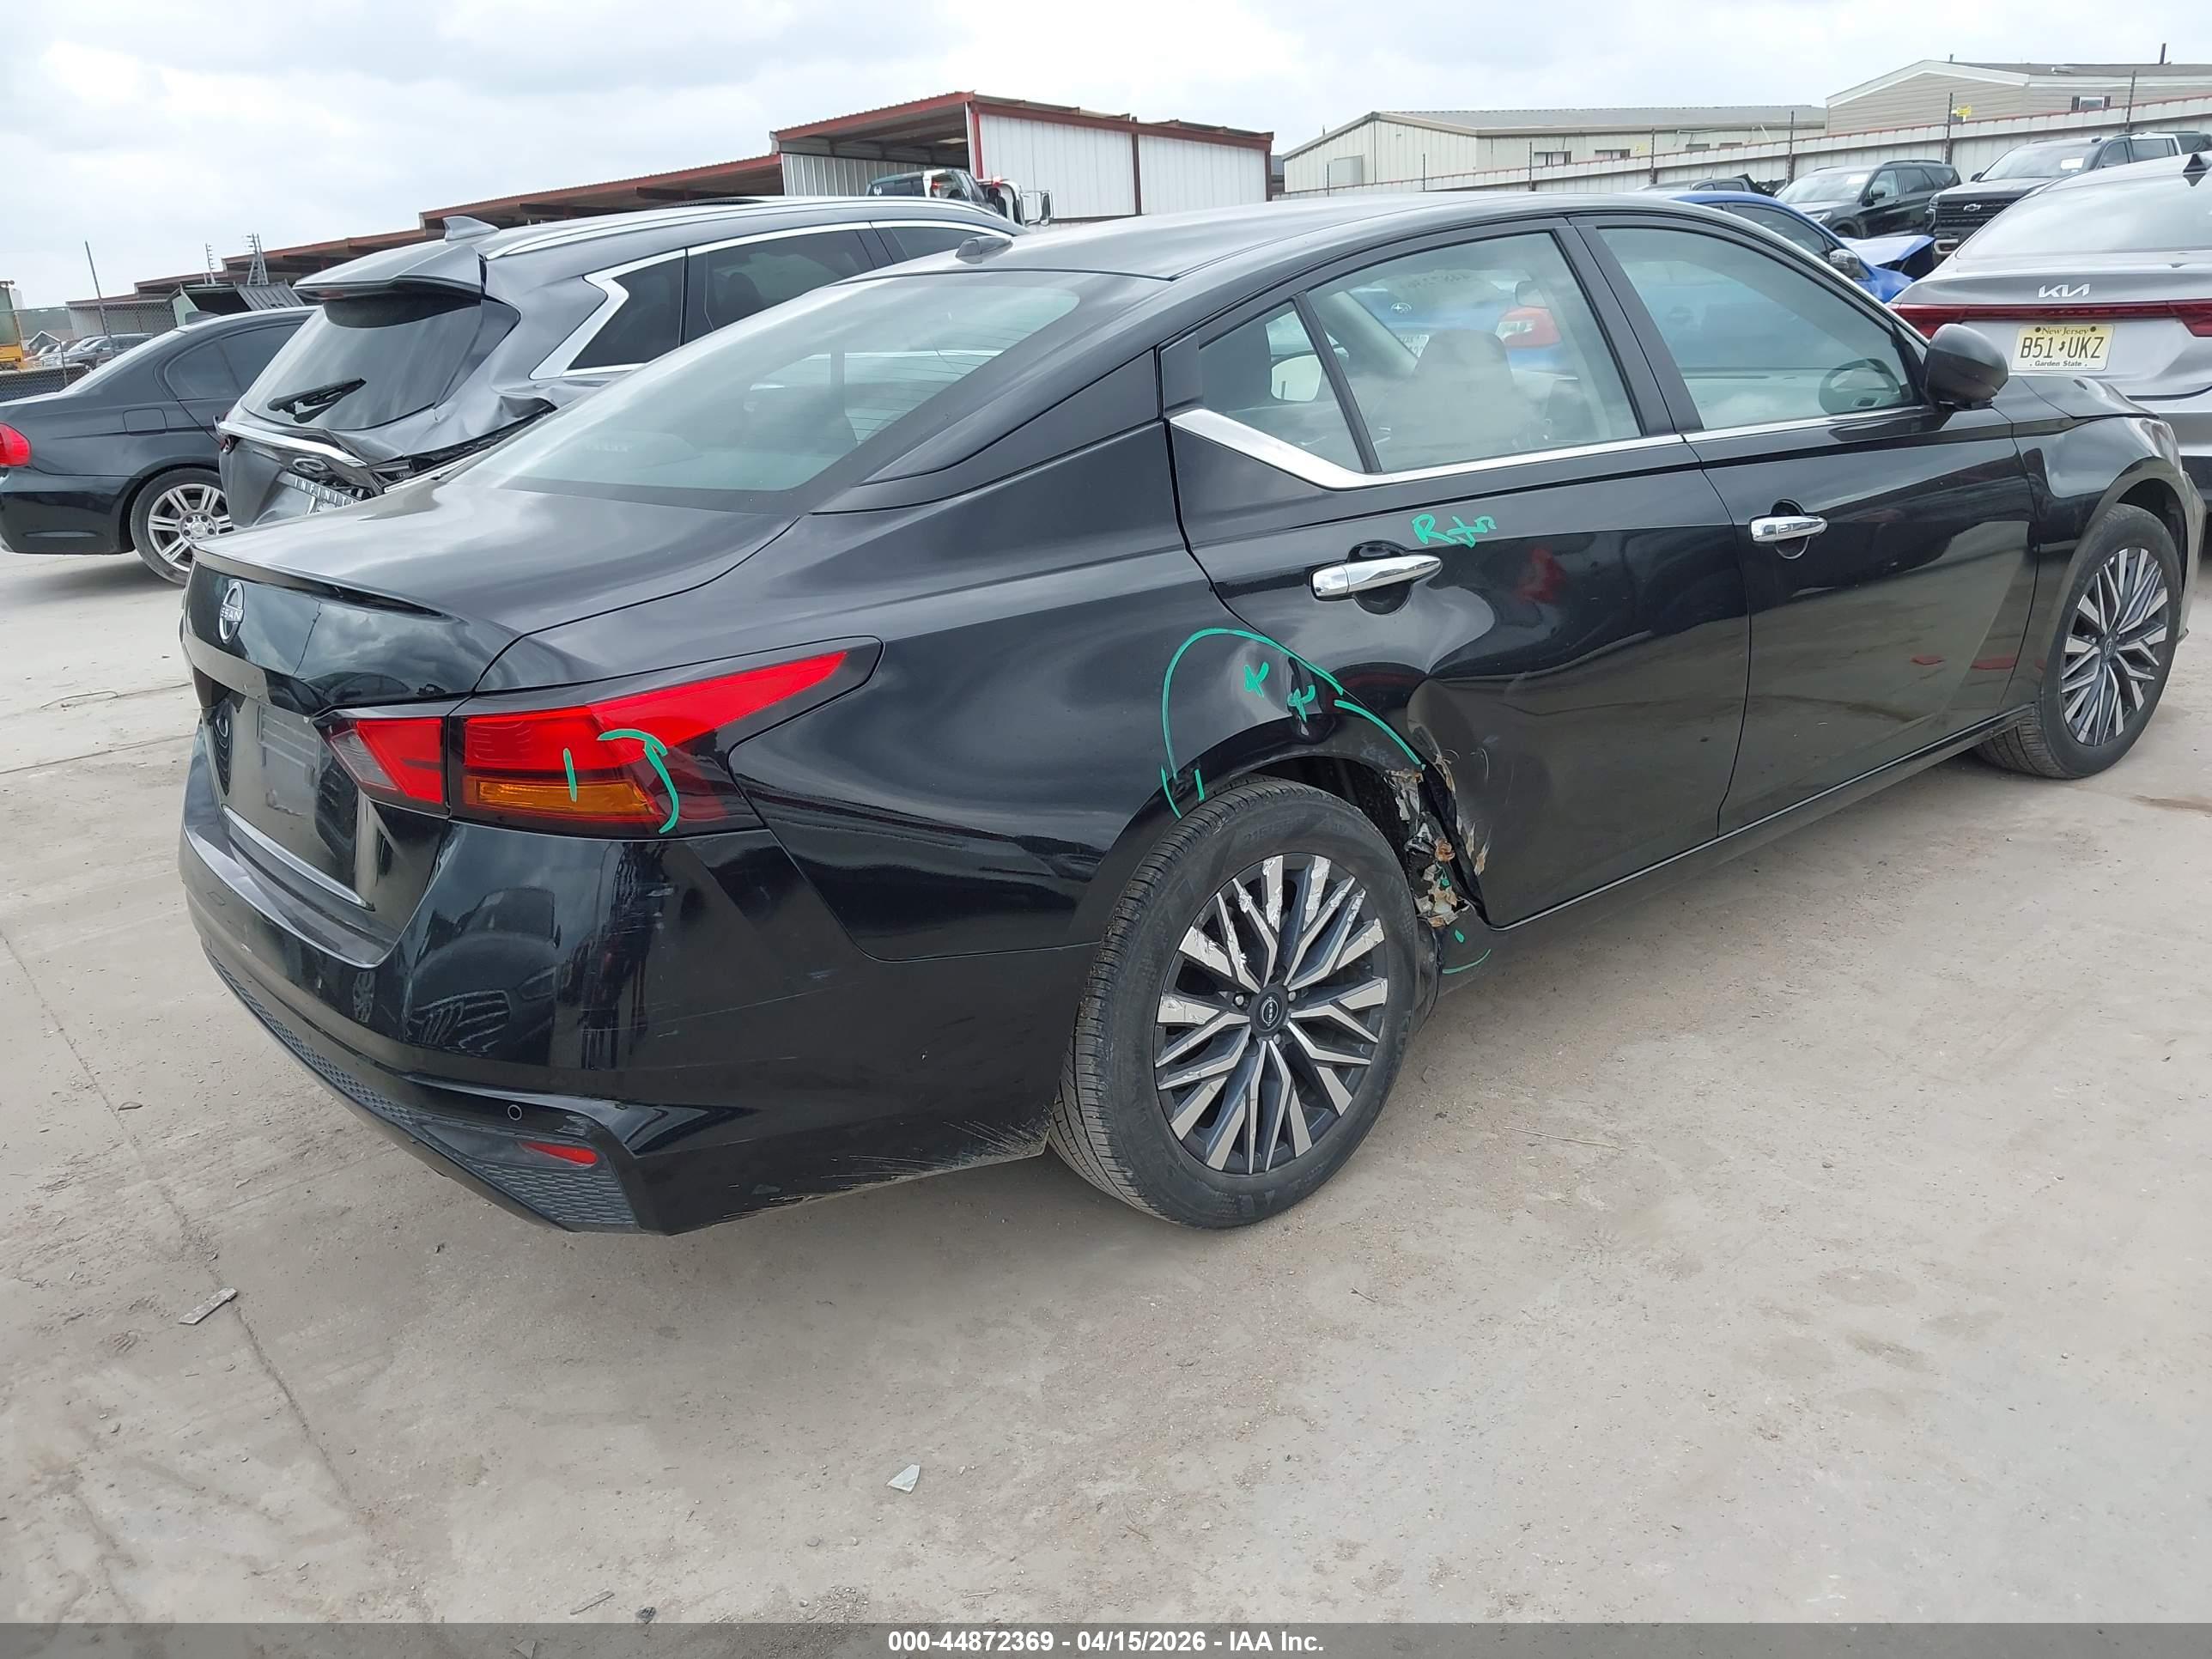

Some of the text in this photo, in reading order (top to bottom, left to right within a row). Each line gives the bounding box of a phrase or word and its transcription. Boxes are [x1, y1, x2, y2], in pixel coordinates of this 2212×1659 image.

[2039, 283, 2090, 298] KIA
[2062, 327, 2089, 336] Jersey
[2020, 337, 2104, 358] B51 UKZ
